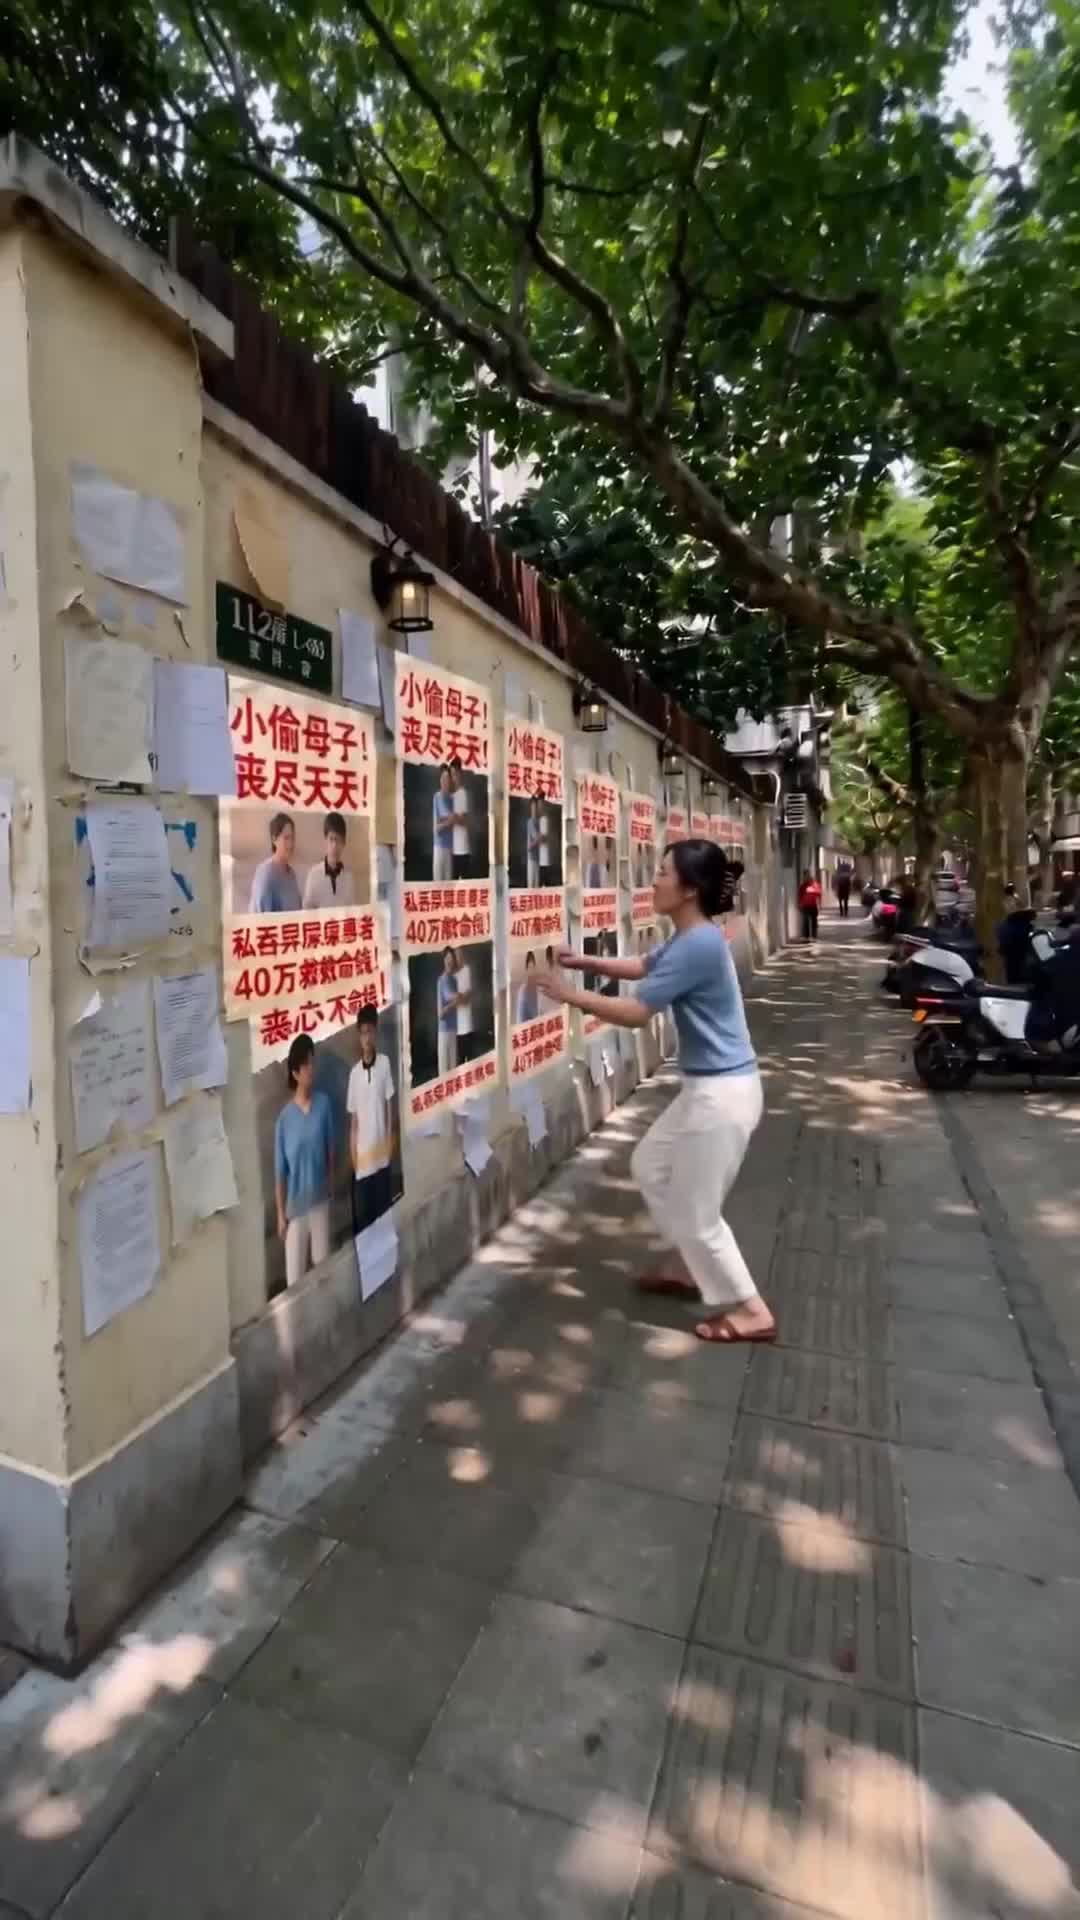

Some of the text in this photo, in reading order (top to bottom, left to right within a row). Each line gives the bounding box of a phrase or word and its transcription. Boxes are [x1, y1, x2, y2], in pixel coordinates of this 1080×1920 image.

[230, 697, 369, 761] 小偷母子！
[400, 671, 488, 729] 小偷母子！
[234, 751, 369, 809] 丧尽天天！
